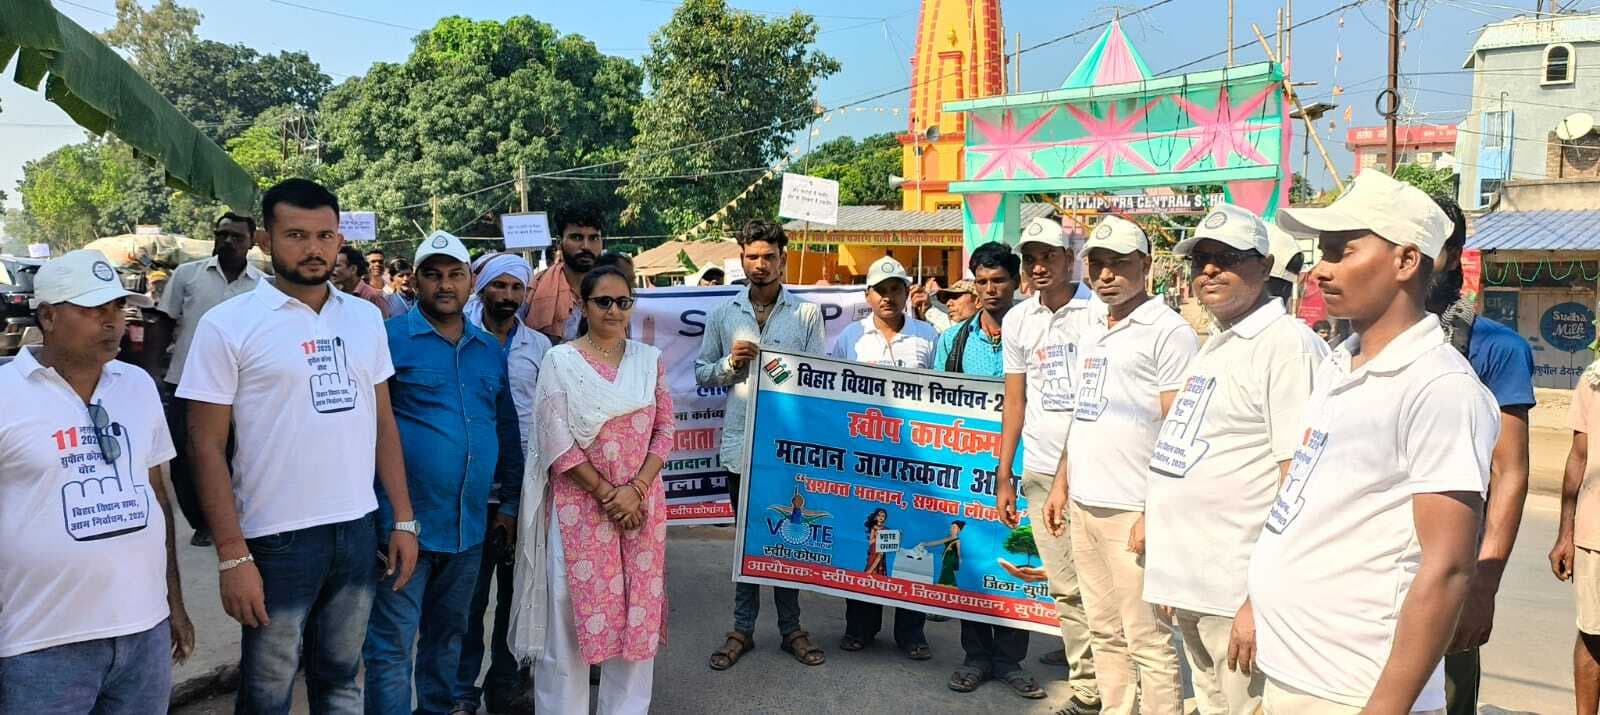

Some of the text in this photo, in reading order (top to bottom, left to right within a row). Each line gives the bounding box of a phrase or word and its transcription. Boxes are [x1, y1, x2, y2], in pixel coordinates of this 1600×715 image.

[1552, 322, 1585, 337] Milk
[797, 362, 837, 391] बिहार
[848, 408, 903, 443] स्वीप
[51, 426, 79, 451] 11
[81, 434, 100, 446] 202
[774, 439, 847, 471] मतदान
[129, 511, 146, 521] 2025
